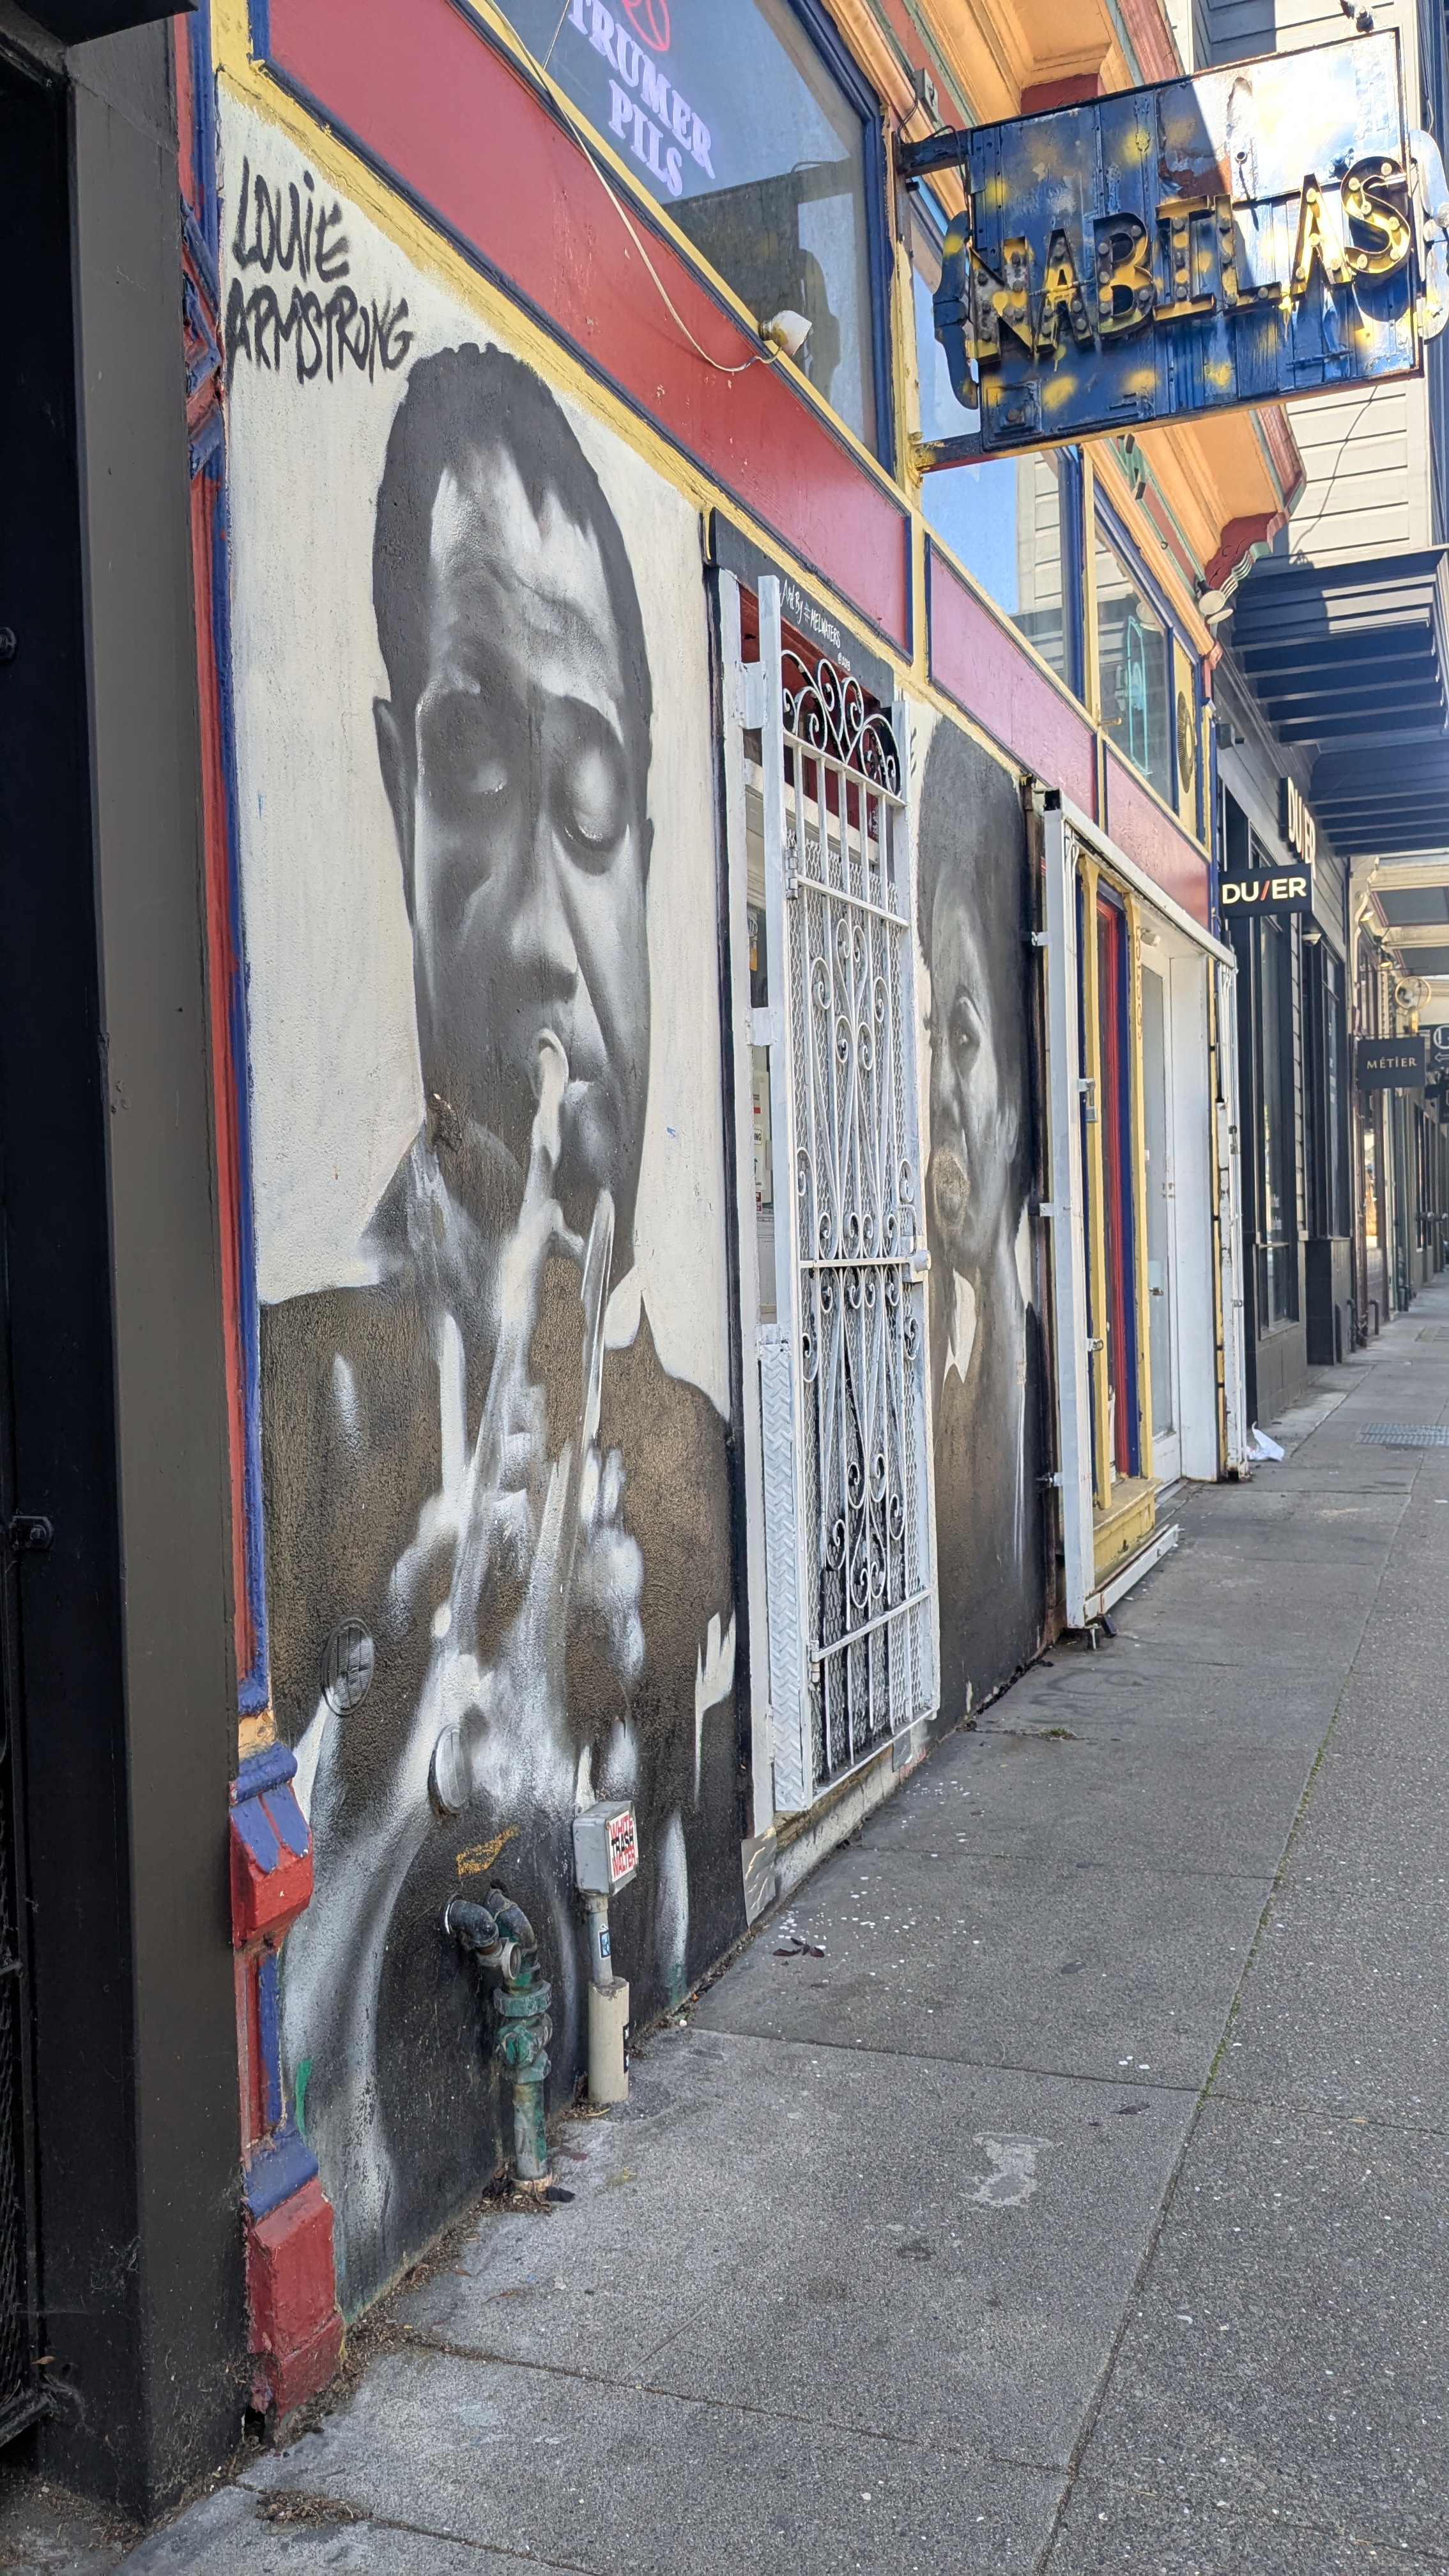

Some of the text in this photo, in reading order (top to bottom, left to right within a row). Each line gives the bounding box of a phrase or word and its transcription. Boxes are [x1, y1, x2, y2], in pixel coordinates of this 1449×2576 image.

[609, 79, 682, 197] PILS
[969, 156, 1411, 365] NABILAS
[224, 277, 415, 395] ARMSTRONG
[1222, 876, 1307, 904] DU/ER
[609, 1814, 634, 1840] WHITE
[611, 1826, 634, 1857] TRASH
[611, 1844, 636, 1878] WALTER
